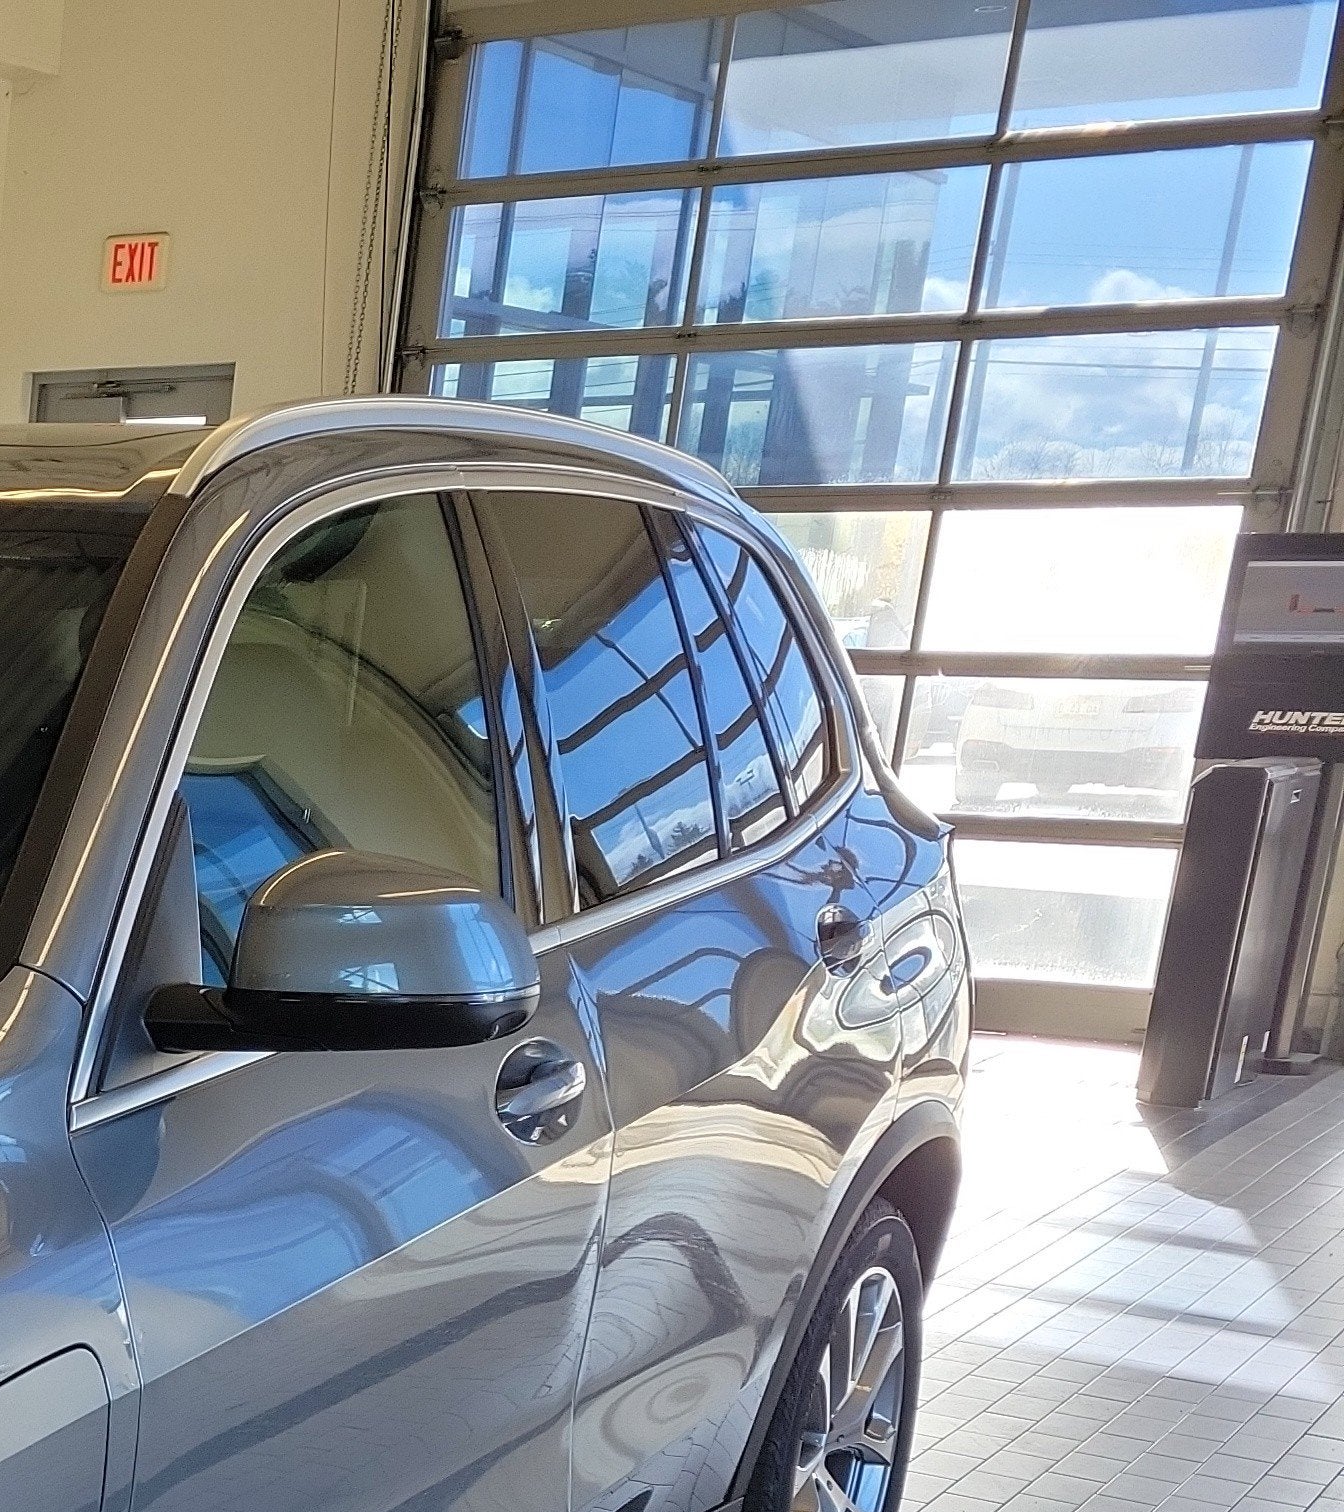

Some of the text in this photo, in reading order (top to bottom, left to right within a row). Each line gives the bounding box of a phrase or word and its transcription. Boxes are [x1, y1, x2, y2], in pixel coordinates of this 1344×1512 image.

[112, 242, 159, 283] EXIT
[1252, 710, 1344, 725] HUNTE
[1249, 723, 1307, 733] Engineering
